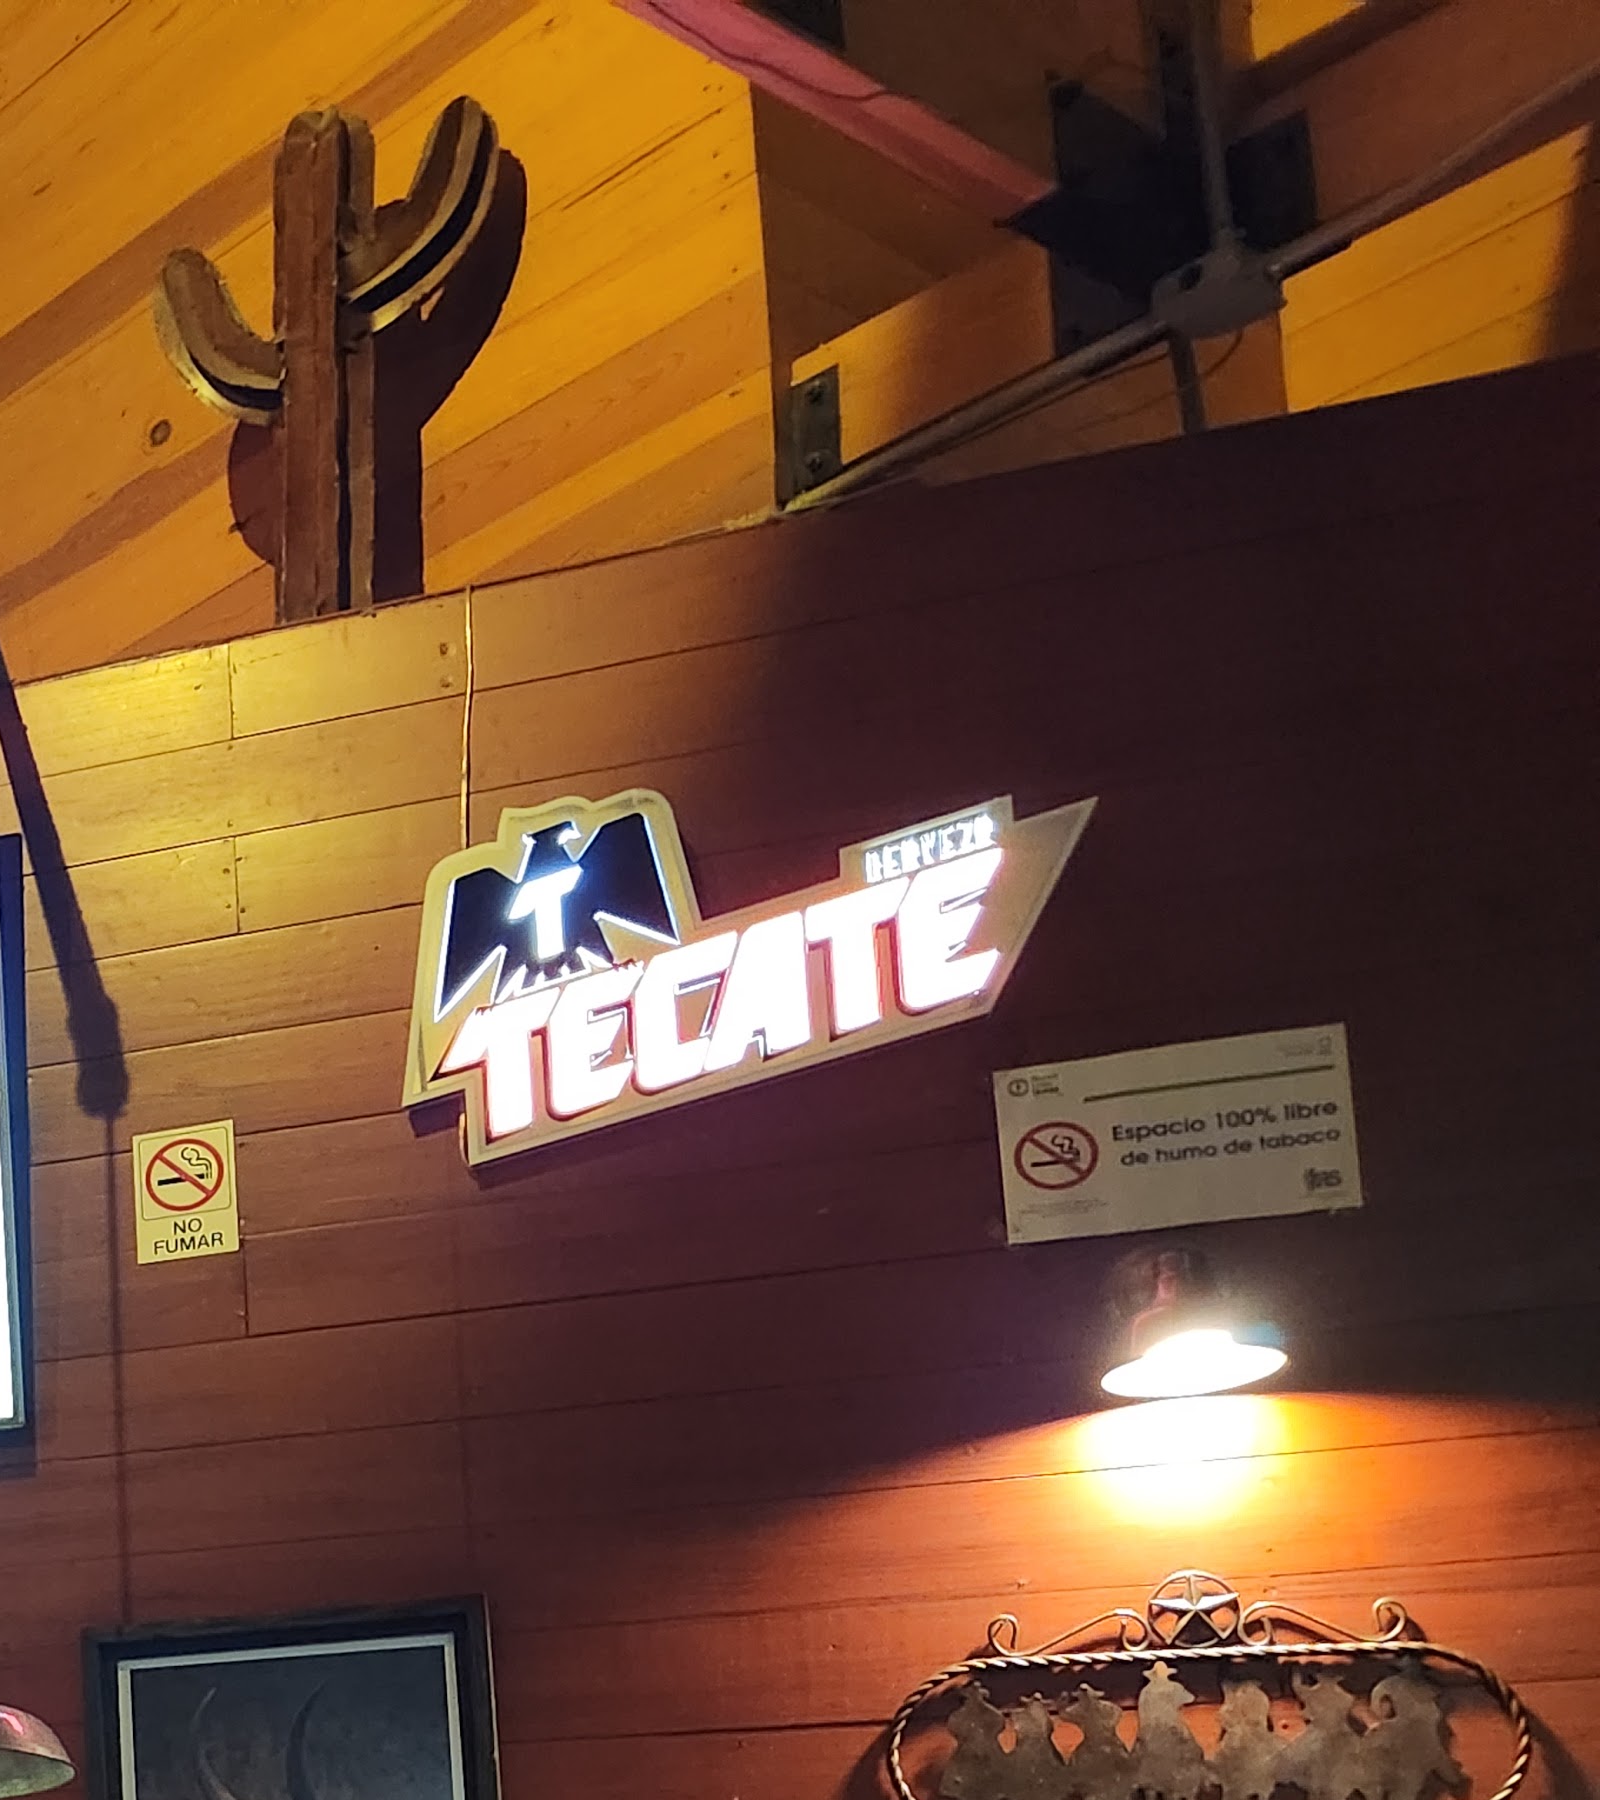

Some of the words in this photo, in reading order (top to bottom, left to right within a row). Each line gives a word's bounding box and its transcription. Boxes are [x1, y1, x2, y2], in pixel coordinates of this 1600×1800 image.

[432, 848, 1004, 1140] TECATE
[1112, 1118, 1206, 1143] Espacio
[1216, 1107, 1278, 1129] 100%
[1284, 1102, 1338, 1121] libre
[1120, 1151, 1149, 1167] de
[1155, 1144, 1217, 1163] humo
[1223, 1139, 1252, 1155] de
[1260, 1128, 1341, 1150] tabaco
[154, 1232, 224, 1255] FUMAR
[173, 1218, 203, 1235] NO
